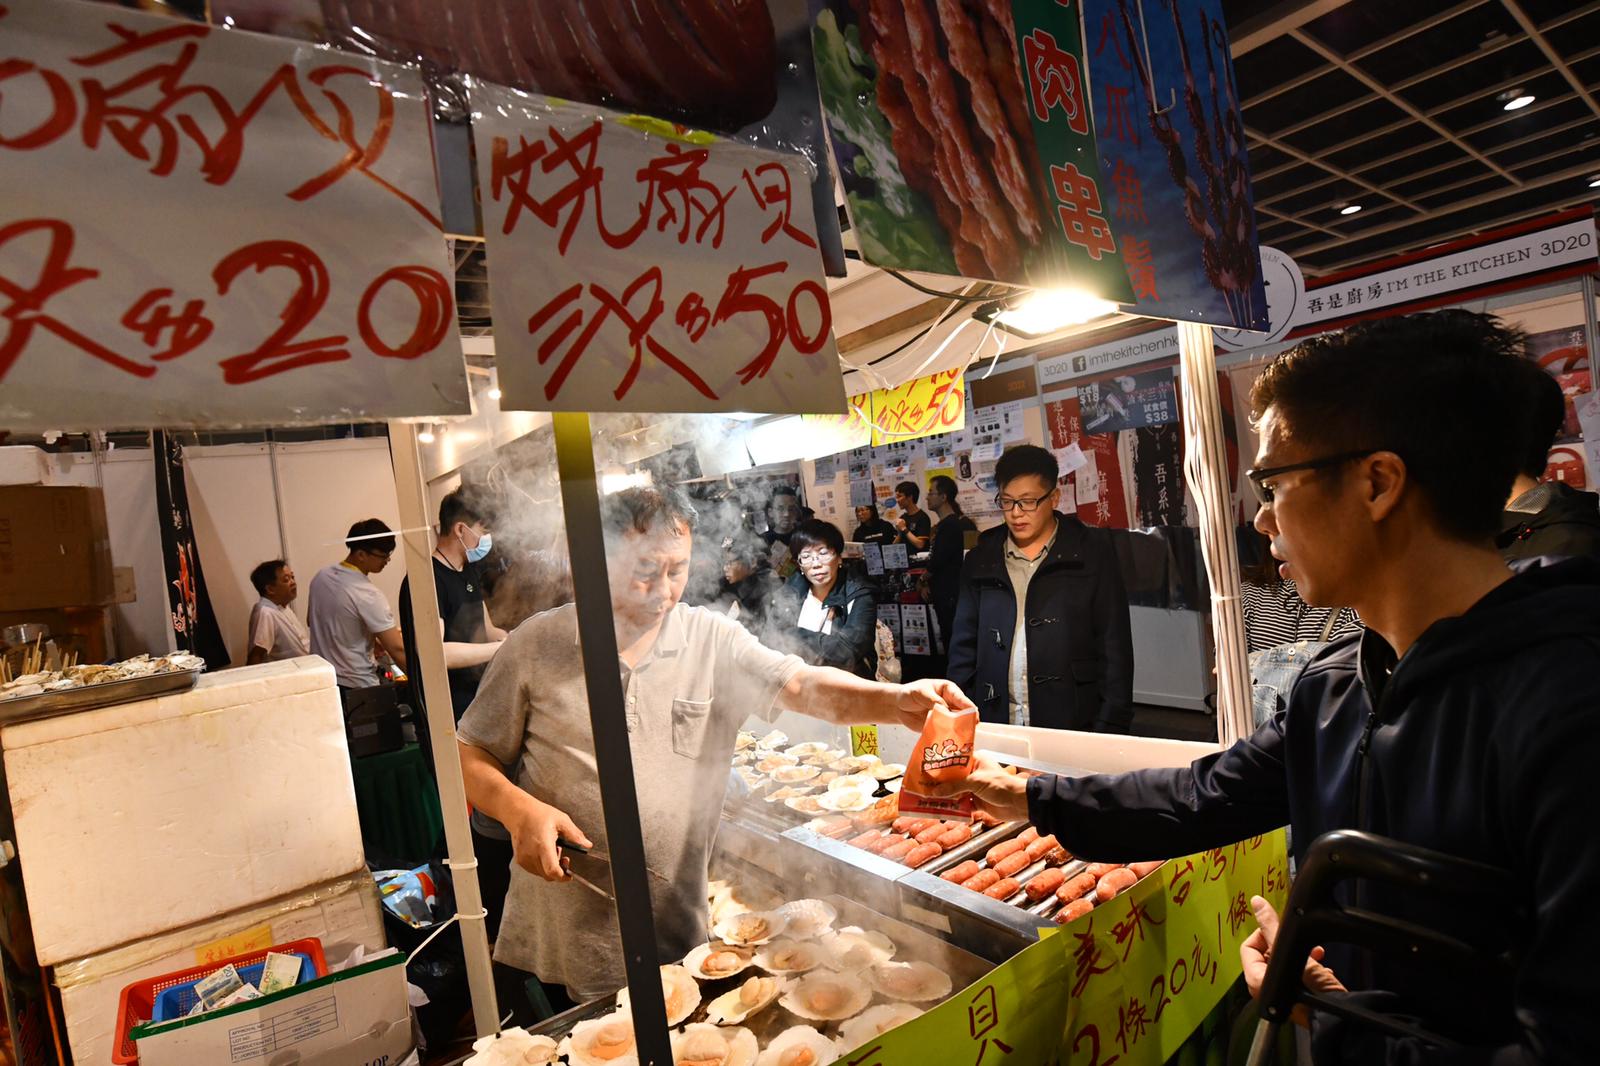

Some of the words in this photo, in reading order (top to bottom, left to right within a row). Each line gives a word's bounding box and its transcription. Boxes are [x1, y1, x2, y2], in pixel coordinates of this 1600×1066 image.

[1022, 0, 1117, 261] 肉串
[1307, 283, 1384, 315] 吾是廚房
[1413, 269, 1447, 287] THE
[1451, 247, 1531, 278] KITCHEN
[1540, 231, 1592, 257] 3D20
[1044, 362, 1068, 377] 3D20
